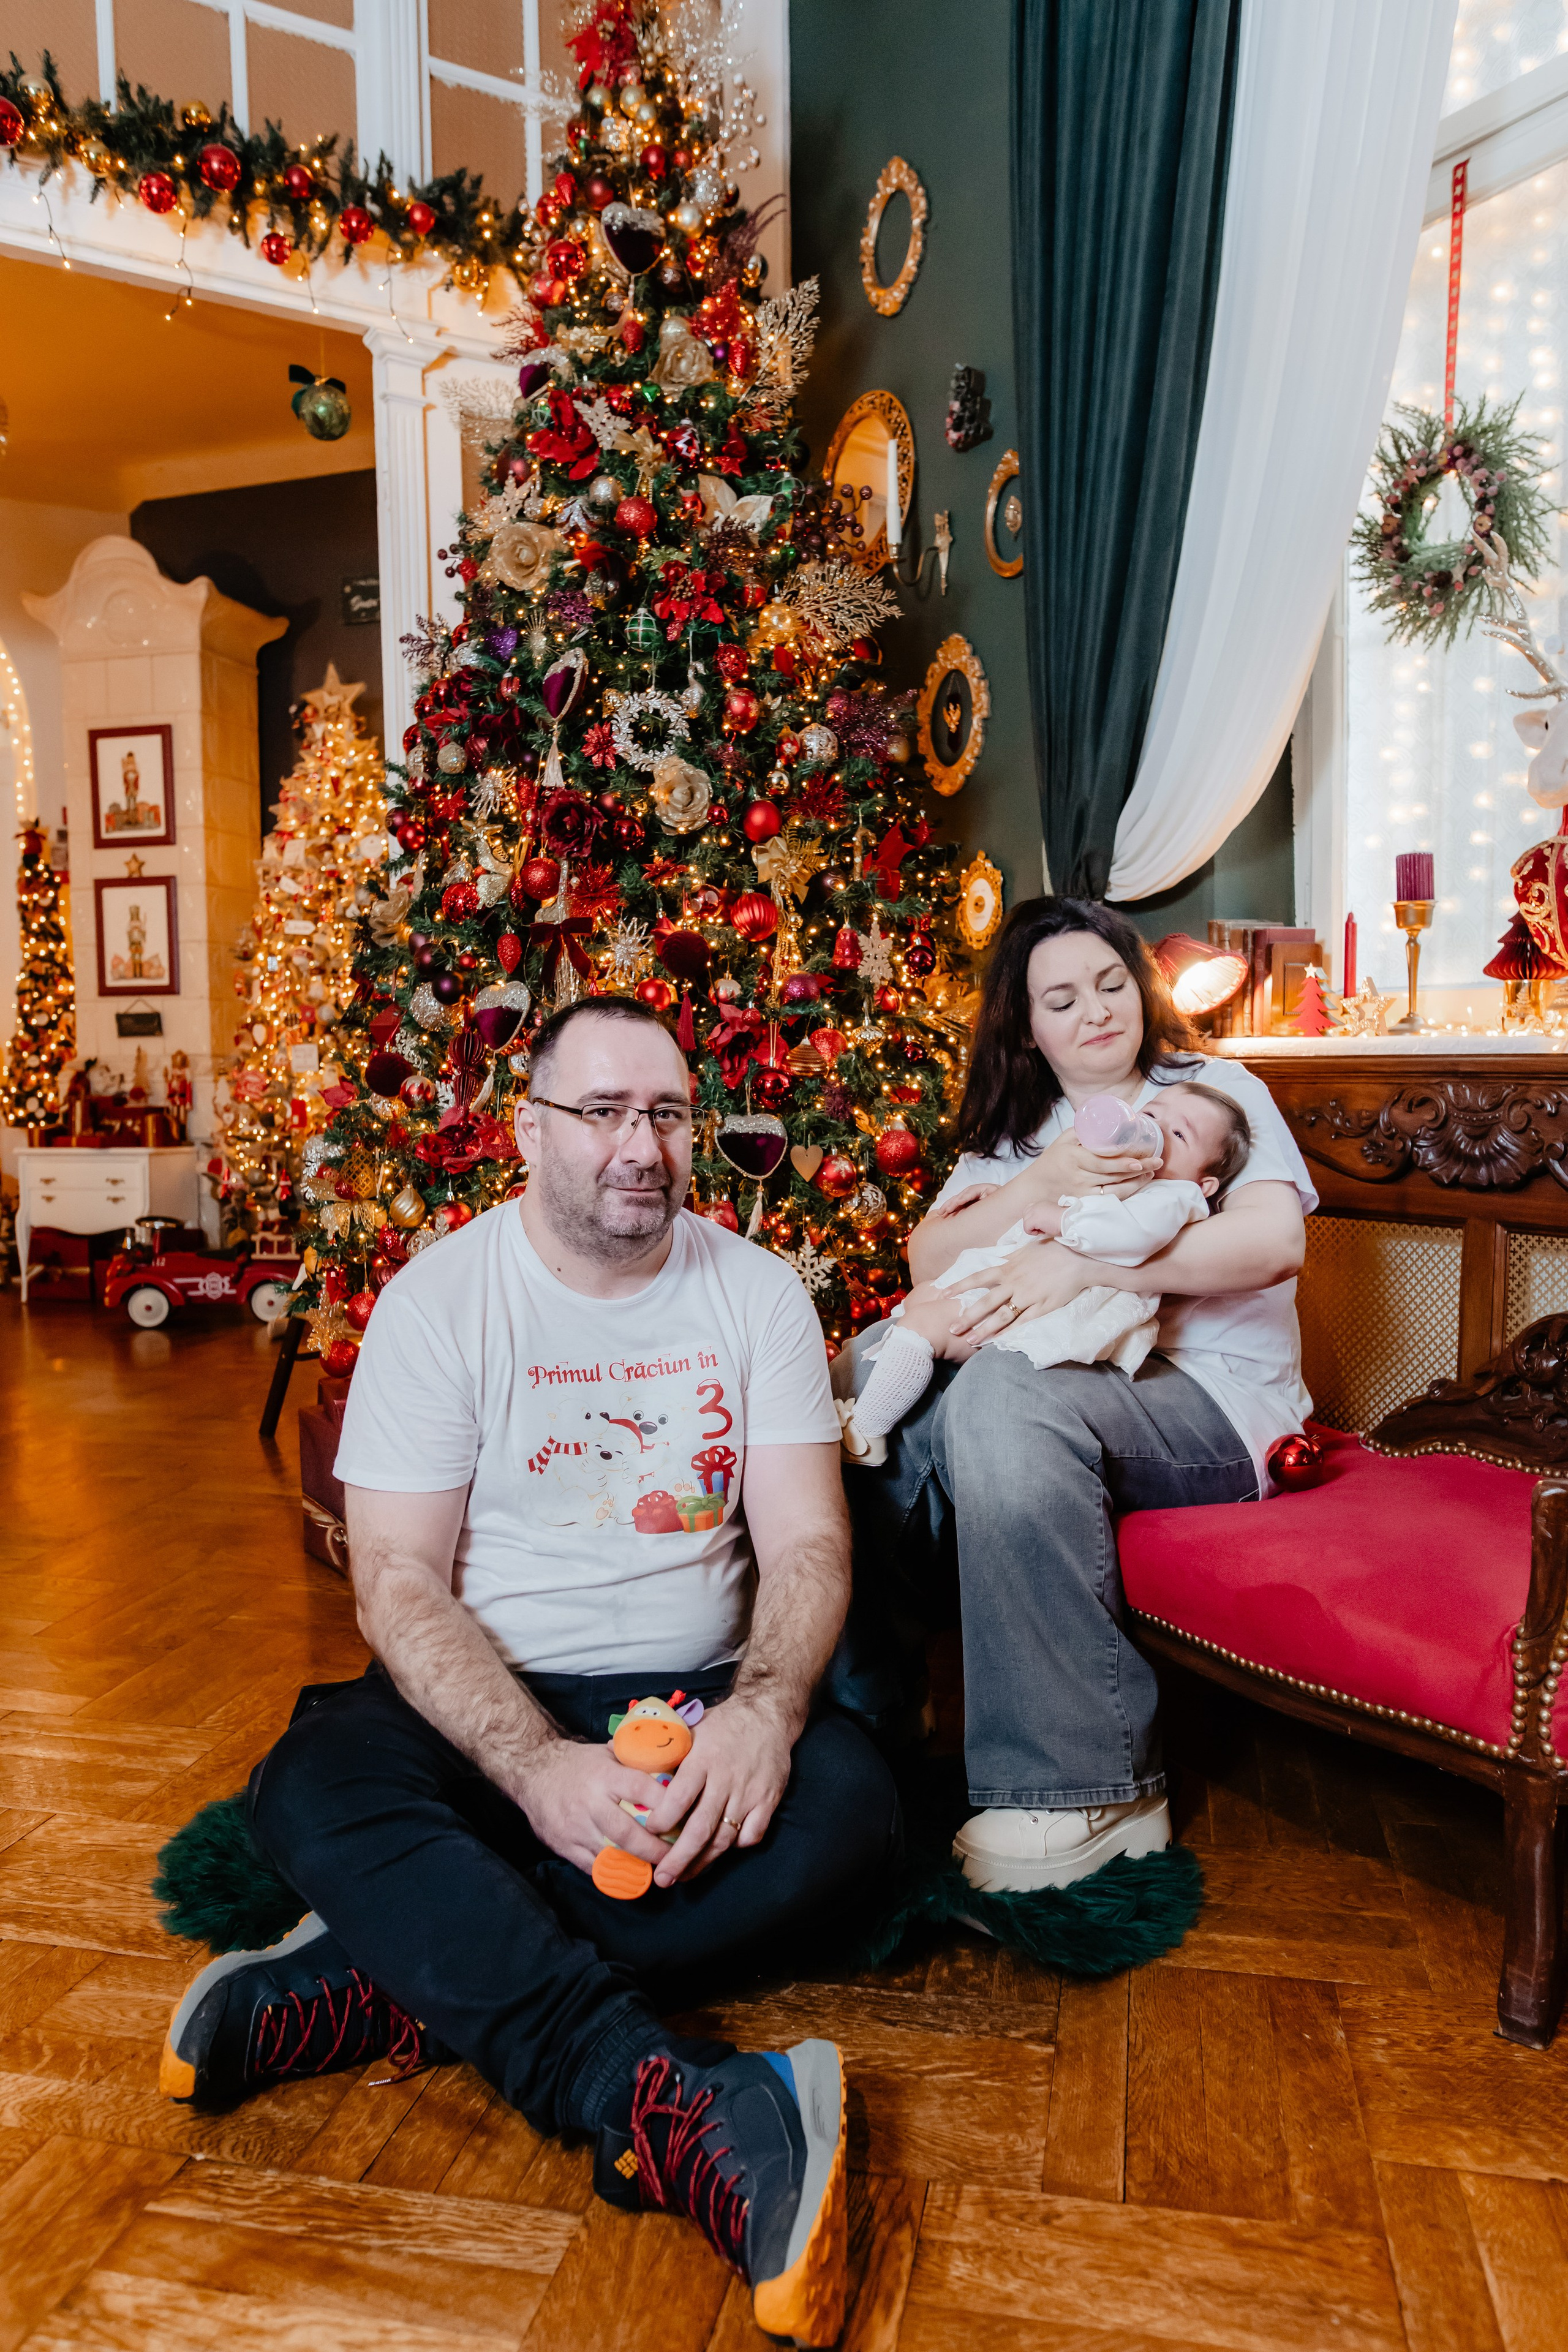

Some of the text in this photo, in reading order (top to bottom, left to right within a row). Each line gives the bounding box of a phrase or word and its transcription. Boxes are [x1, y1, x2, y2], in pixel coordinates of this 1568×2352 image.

[527, 1351, 718, 1389] Primul Crăciun în
[696, 1382, 733, 1440] 3
